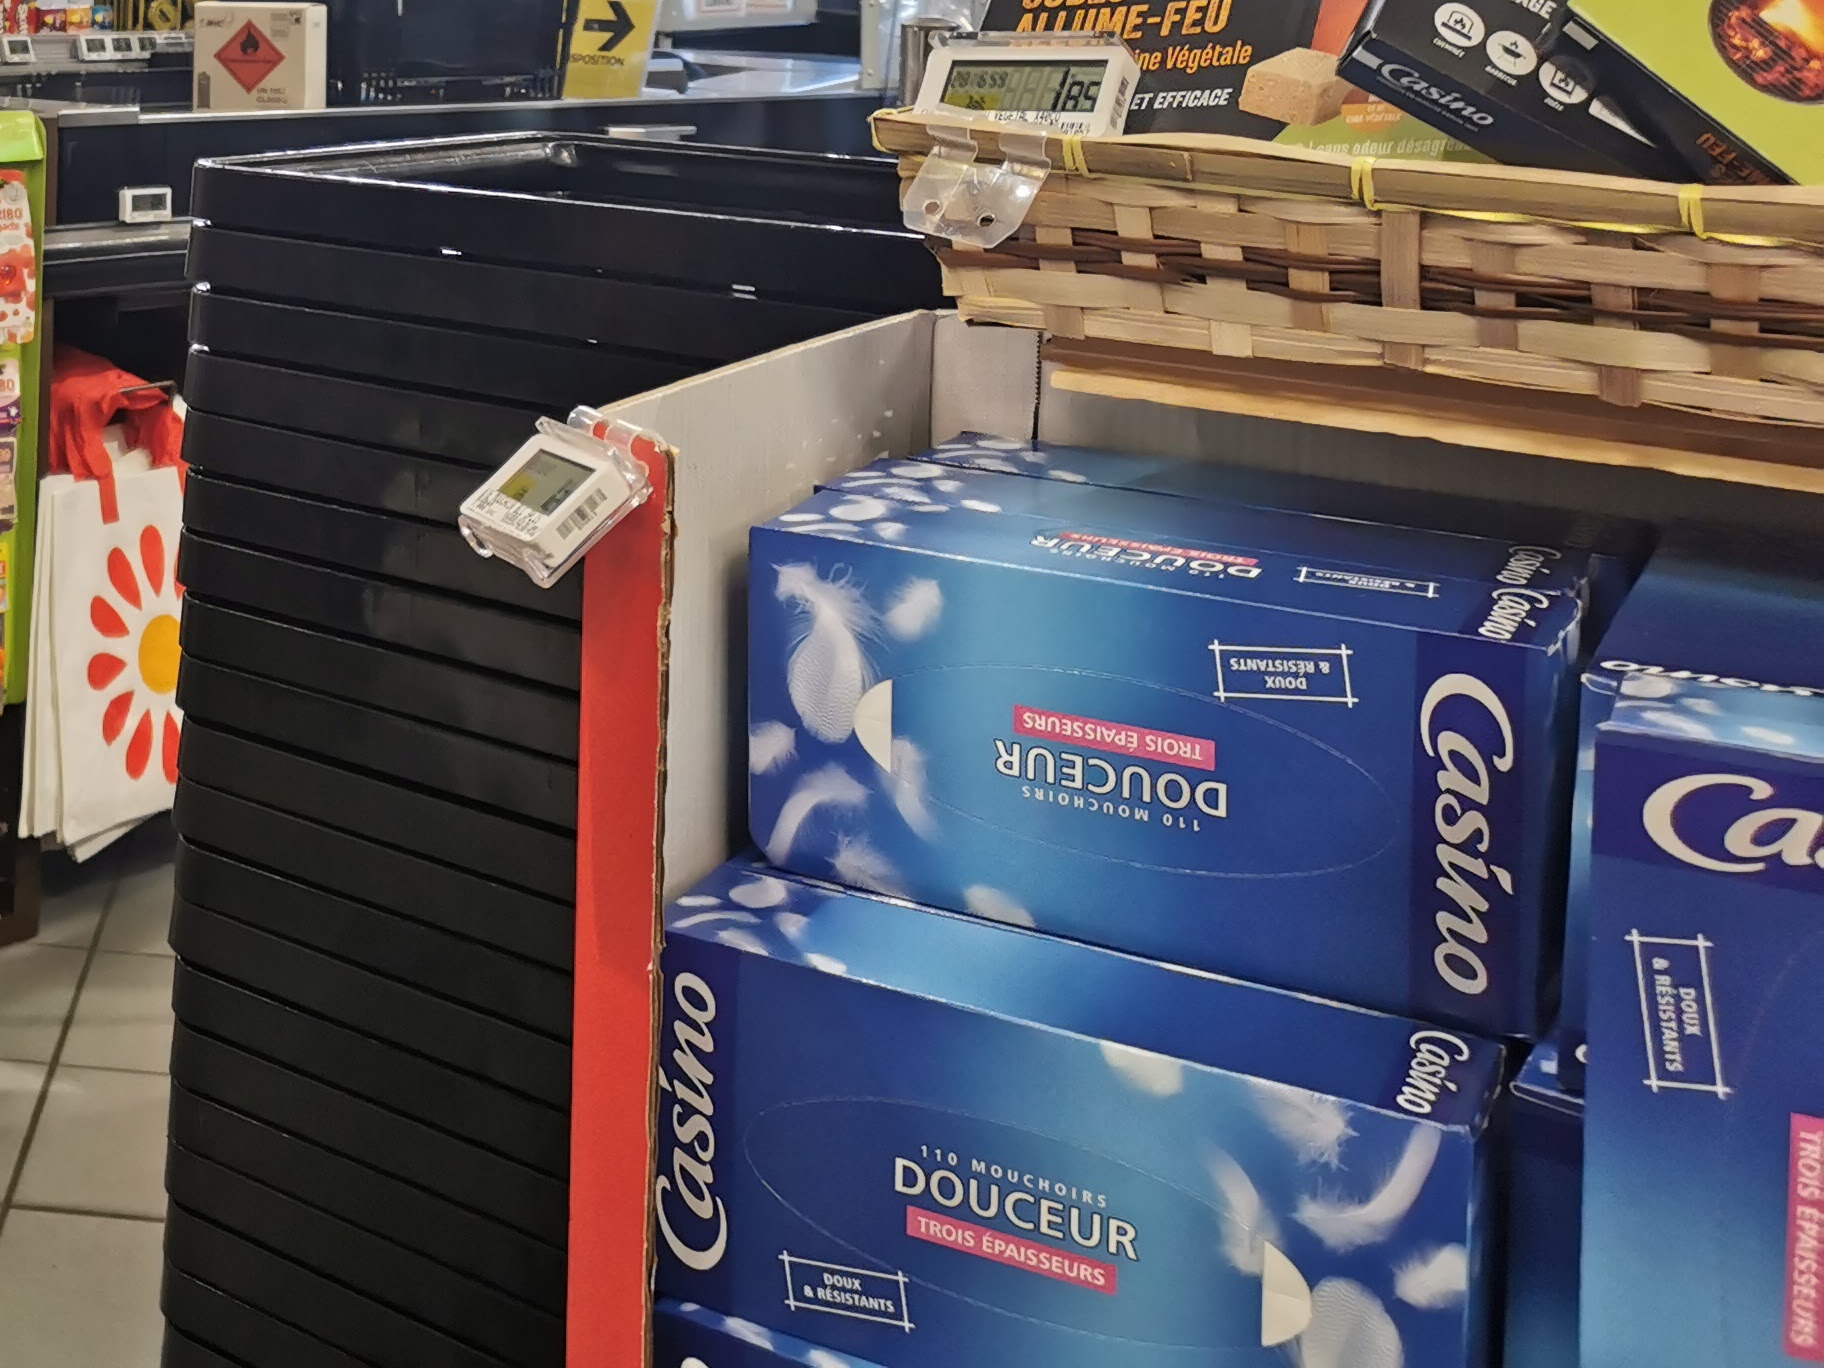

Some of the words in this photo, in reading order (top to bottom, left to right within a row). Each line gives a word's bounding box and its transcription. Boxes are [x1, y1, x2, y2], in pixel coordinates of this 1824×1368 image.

[1166, 40, 1253, 75] Végétale
[1130, 94, 1149, 110] ET
[1153, 88, 1234, 109] EFFICACE
[1380, 64, 1494, 126] Casino
[1029, 535, 1263, 580] DOUCEUR
[1496, 545, 1561, 585] Casino
[1478, 587, 1549, 641] Casino
[1230, 657, 1316, 674] RÉSISTANTS
[1265, 675, 1307, 690] DOUX
[1318, 660, 1330, 674] &
[1022, 711, 1139, 753] ÉPAISSEURS
[1145, 735, 1204, 761] TROIS
[993, 738, 1228, 819] DOUCEUR
[1022, 786, 1149, 823] MOUCHOIRS
[1163, 812, 1200, 832] 110
[1643, 773, 1824, 873] Ca
[1419, 670, 1516, 996] Casino
[1654, 975, 1685, 1073] RÉSISTANTS
[1679, 986, 1703, 1037] DOUX
[1396, 1030, 1470, 1114] Casino
[656, 972, 728, 1271] Casino
[921, 1144, 958, 1166] 110
[971, 1158, 1107, 1208] MOUCHOIRS
[1795, 1130, 1824, 1200] TROIS
[894, 1156, 1140, 1262] DOUCEUR
[917, 1215, 976, 1248] TROIS
[982, 1232, 1106, 1286] ÉPAISSEURS
[803, 1284, 814, 1298] &
[817, 1287, 895, 1314] RÉSISTANTS
[823, 1272, 861, 1291] DOUX
